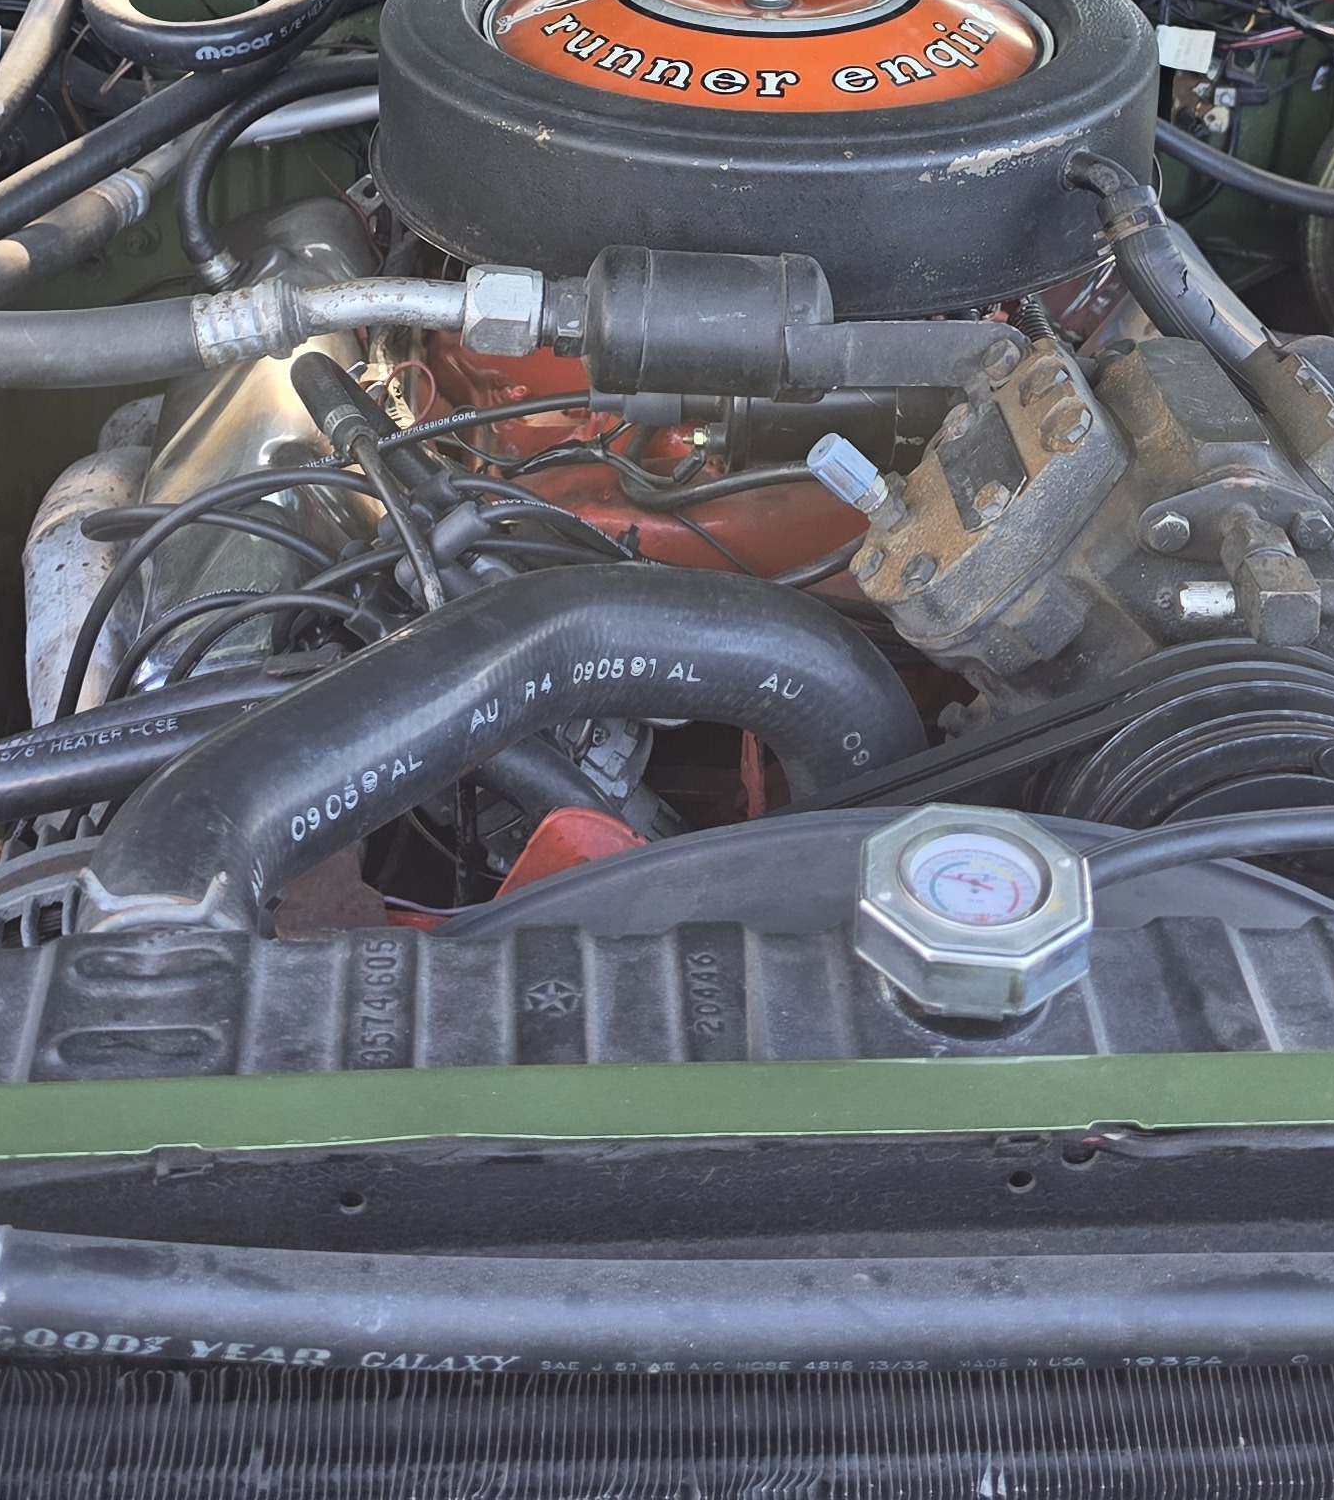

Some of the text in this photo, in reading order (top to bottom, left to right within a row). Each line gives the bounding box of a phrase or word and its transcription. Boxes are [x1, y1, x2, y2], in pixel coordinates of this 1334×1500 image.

[541, 13, 799, 98] runner
[451, 409, 478, 425] CORE
[390, 752, 423, 783] AL
[470, 698, 499, 734] AU
[666, 662, 702, 684] AL
[758, 673, 804, 700] AU
[50, 729, 123, 755] HEATER
[360, 1351, 520, 1373] GALAXY
[540, 1360, 581, 1372] SAE
[688, 1360, 725, 1371] A/C
[736, 1360, 792, 1371] HOSE
[868, 1359, 930, 1371] 13/32
[960, 1357, 1010, 1369] MADE
[1048, 1357, 1087, 1368] USA
